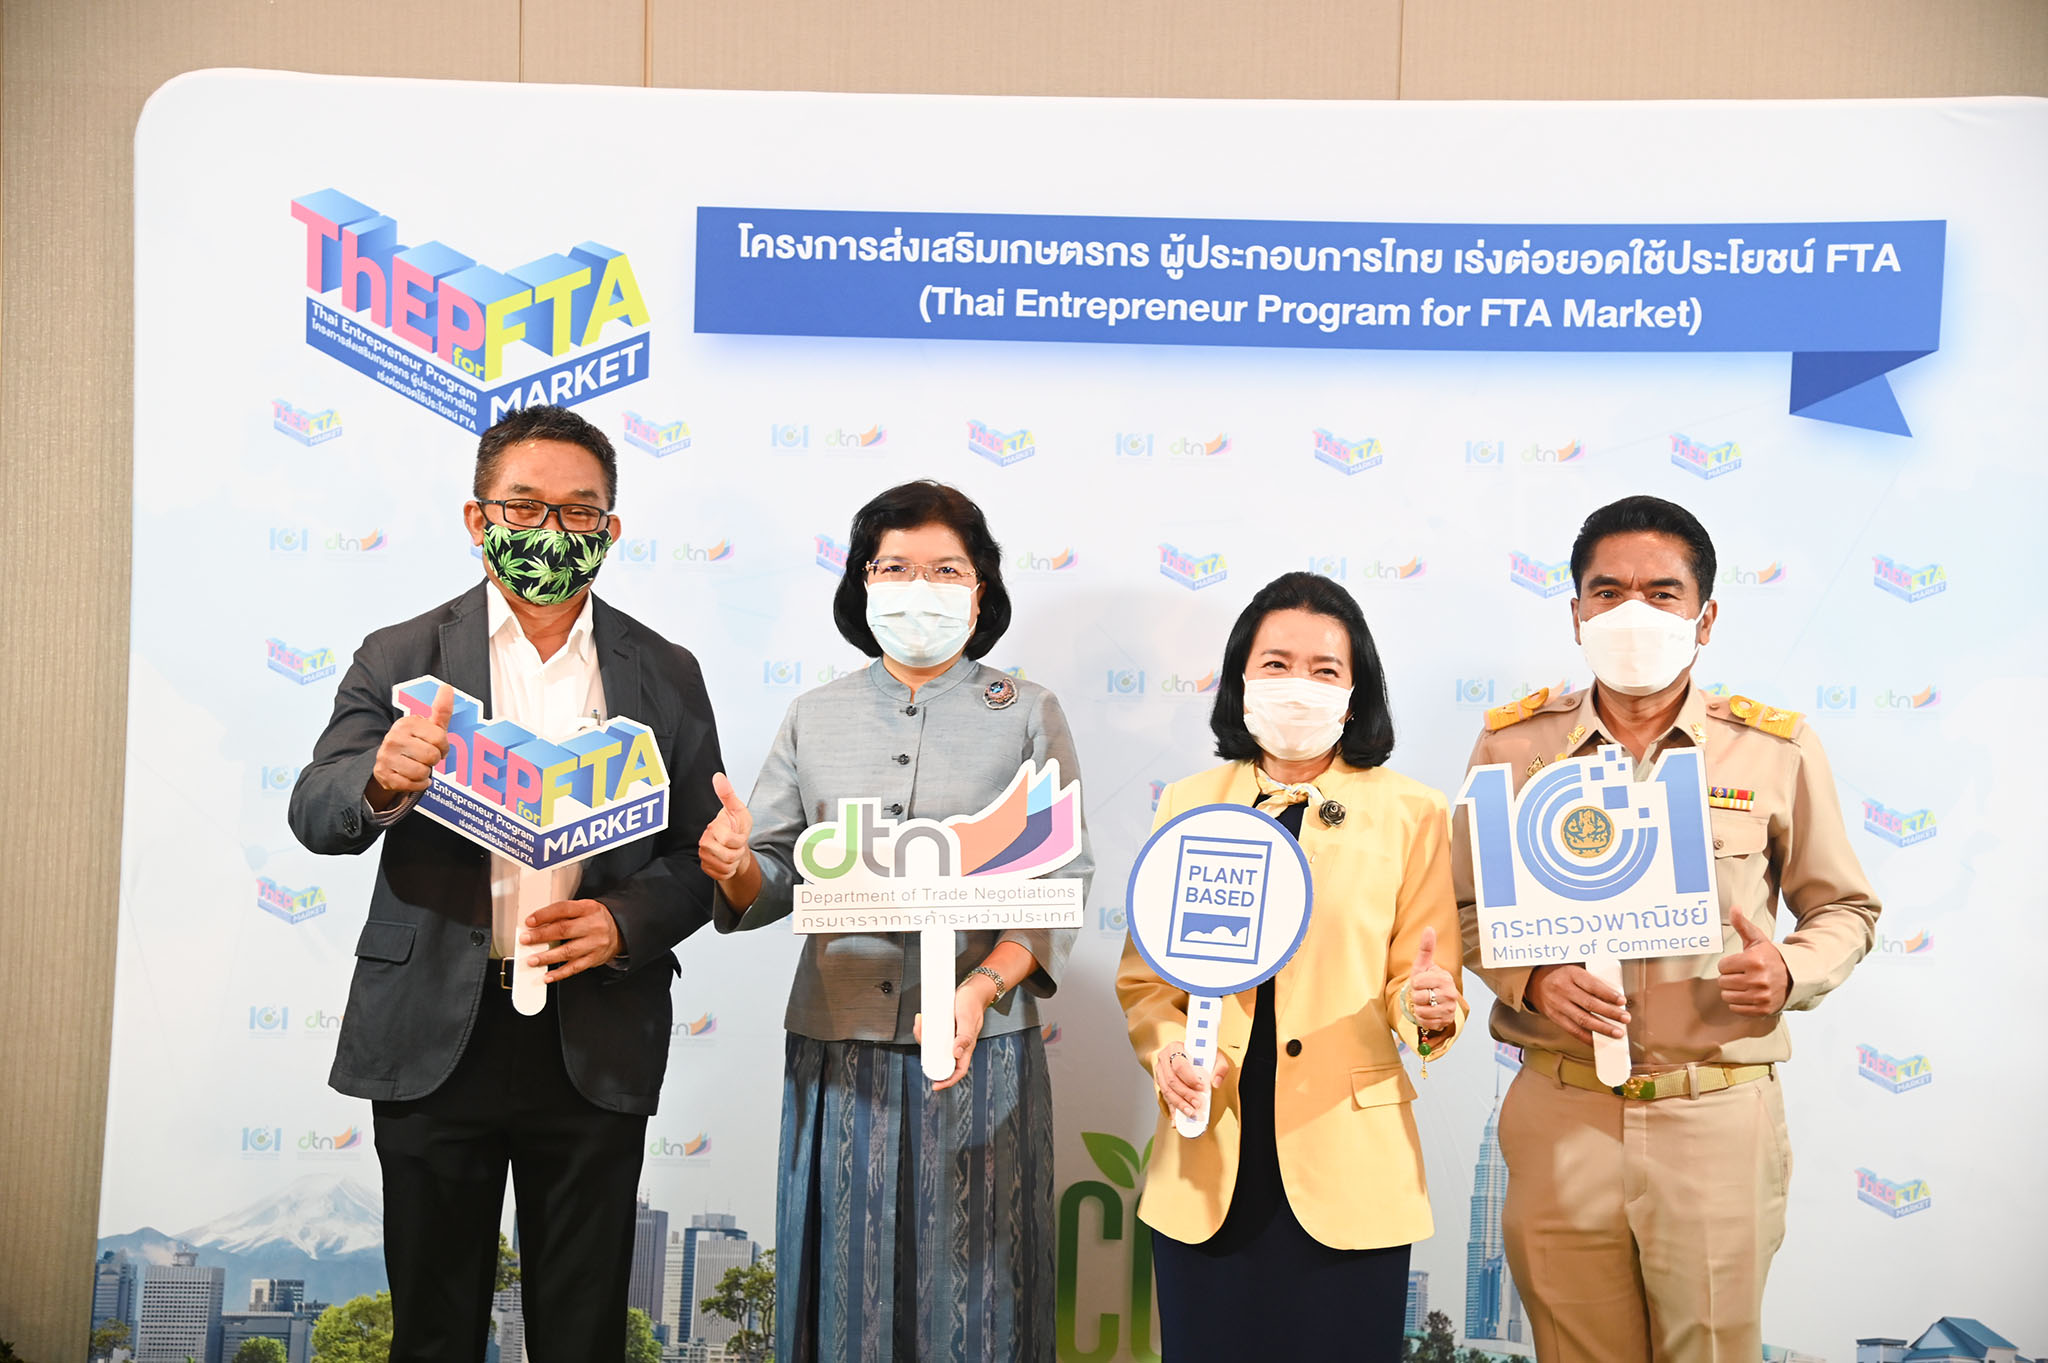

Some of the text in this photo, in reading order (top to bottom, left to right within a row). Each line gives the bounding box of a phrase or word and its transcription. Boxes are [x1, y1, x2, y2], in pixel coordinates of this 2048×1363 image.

[738, 223, 1902, 280] โครงการส่งเสริมเกษตรกร ผู้ประกอบการไทย เร่งต่อยอดใช้ประโยชน์ FTA
[453, 347, 484, 378] for
[485, 253, 651, 382] FTA
[919, 285, 1702, 335] (Thai Entrepreneur Program for FTA Market)
[312, 302, 477, 402] Thai Entrepreneur Program
[491, 343, 643, 427] MARKET
[459, 414, 477, 431] FTA
[518, 801, 540, 824] for
[541, 732, 665, 828] FTA
[433, 780, 535, 842] Entrepreneur Program
[544, 797, 660, 862] MARKET
[520, 852, 534, 864] FTA
[801, 803, 951, 879] dtn
[801, 886, 1076, 906] Department of Trade Negotiations
[1186, 887, 1255, 907] BASED
[1188, 865, 1258, 885] PLANT
[802, 909, 1076, 927] กรมเจรจาการค้าระหว่างประเทศ
[1491, 900, 1708, 939] กระทรวงพาณิชย์
[1492, 935, 1710, 961] Ministry of Commerce
